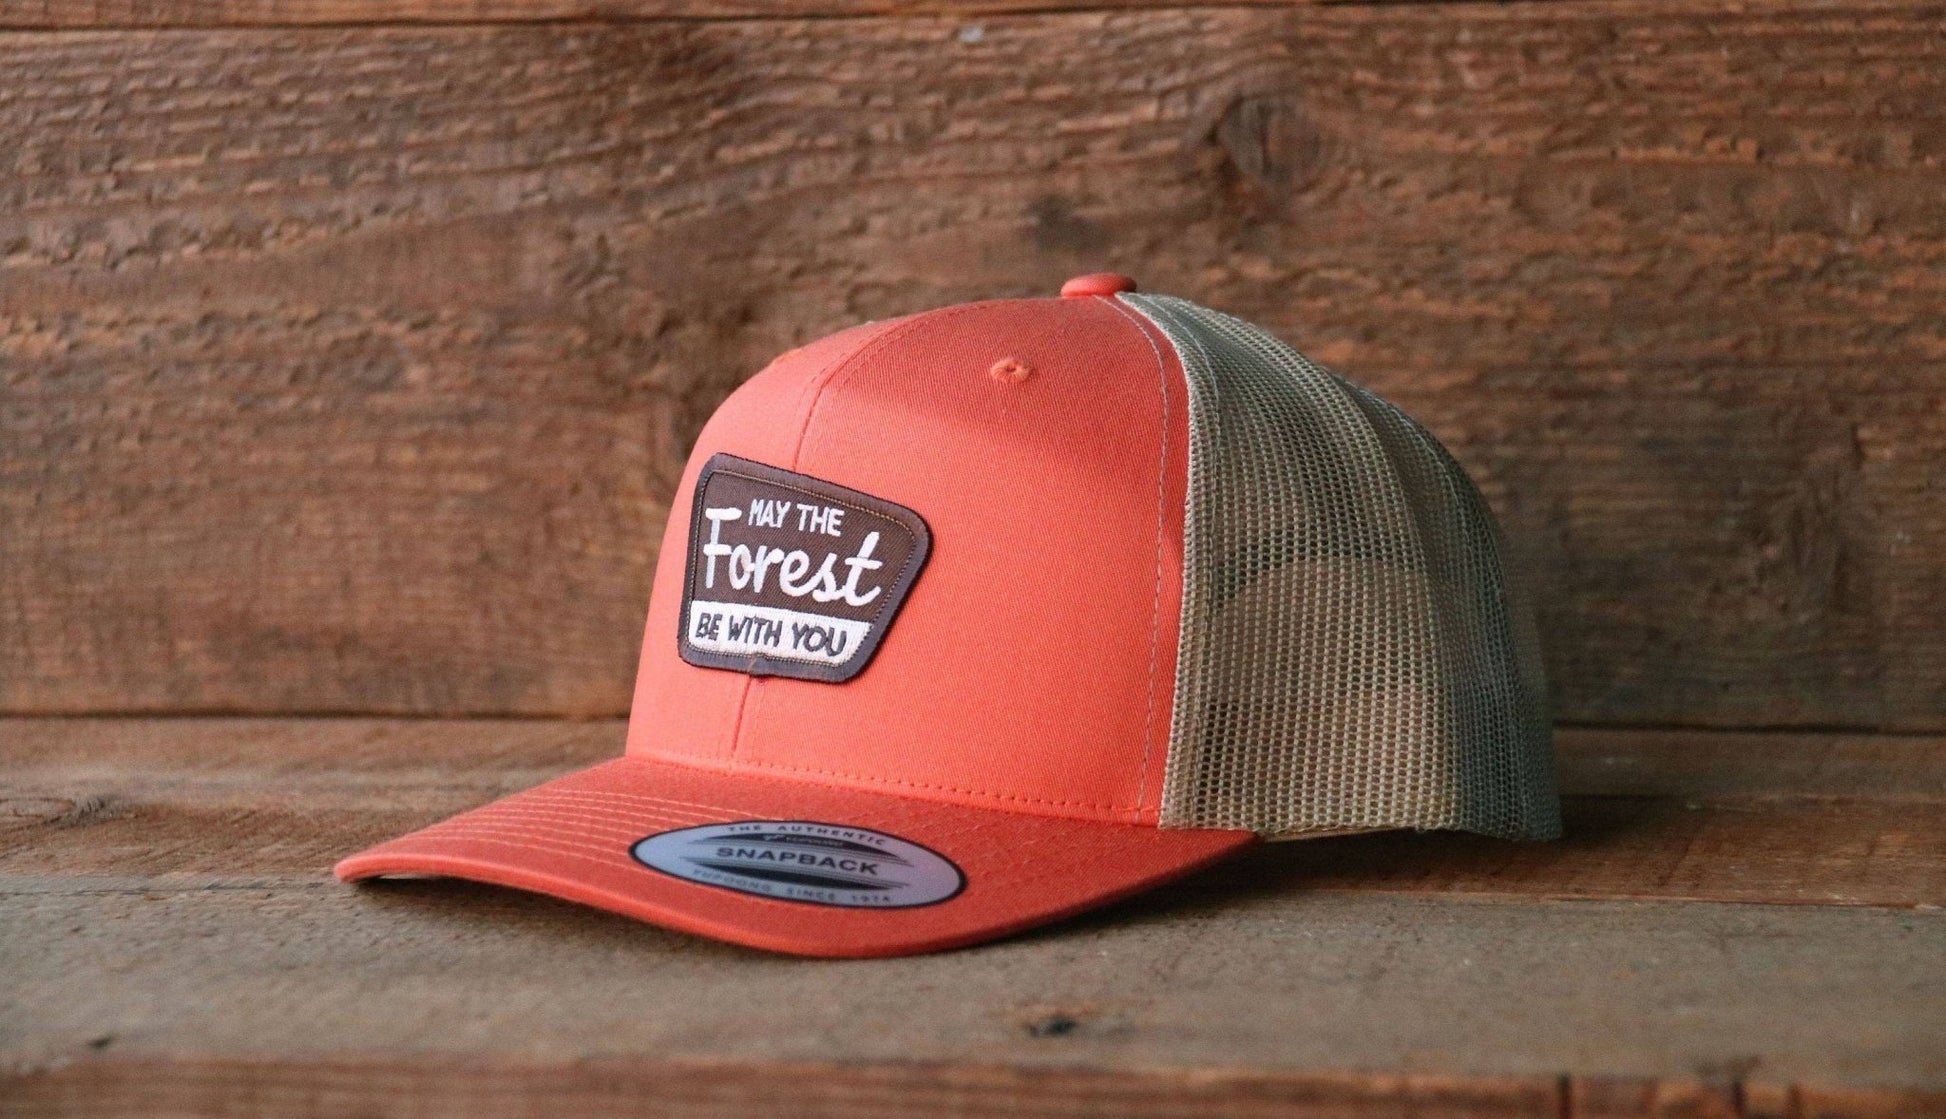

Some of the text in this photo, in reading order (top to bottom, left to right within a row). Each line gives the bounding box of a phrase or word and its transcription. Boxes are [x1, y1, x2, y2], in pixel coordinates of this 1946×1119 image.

[749, 499, 845, 537] MAY THE
[703, 507, 883, 607] Forest
[695, 612, 847, 657] BE WITH YOU
[777, 825, 886, 846] AUTHENTIC
[716, 847, 879, 875] SNAPBACK
